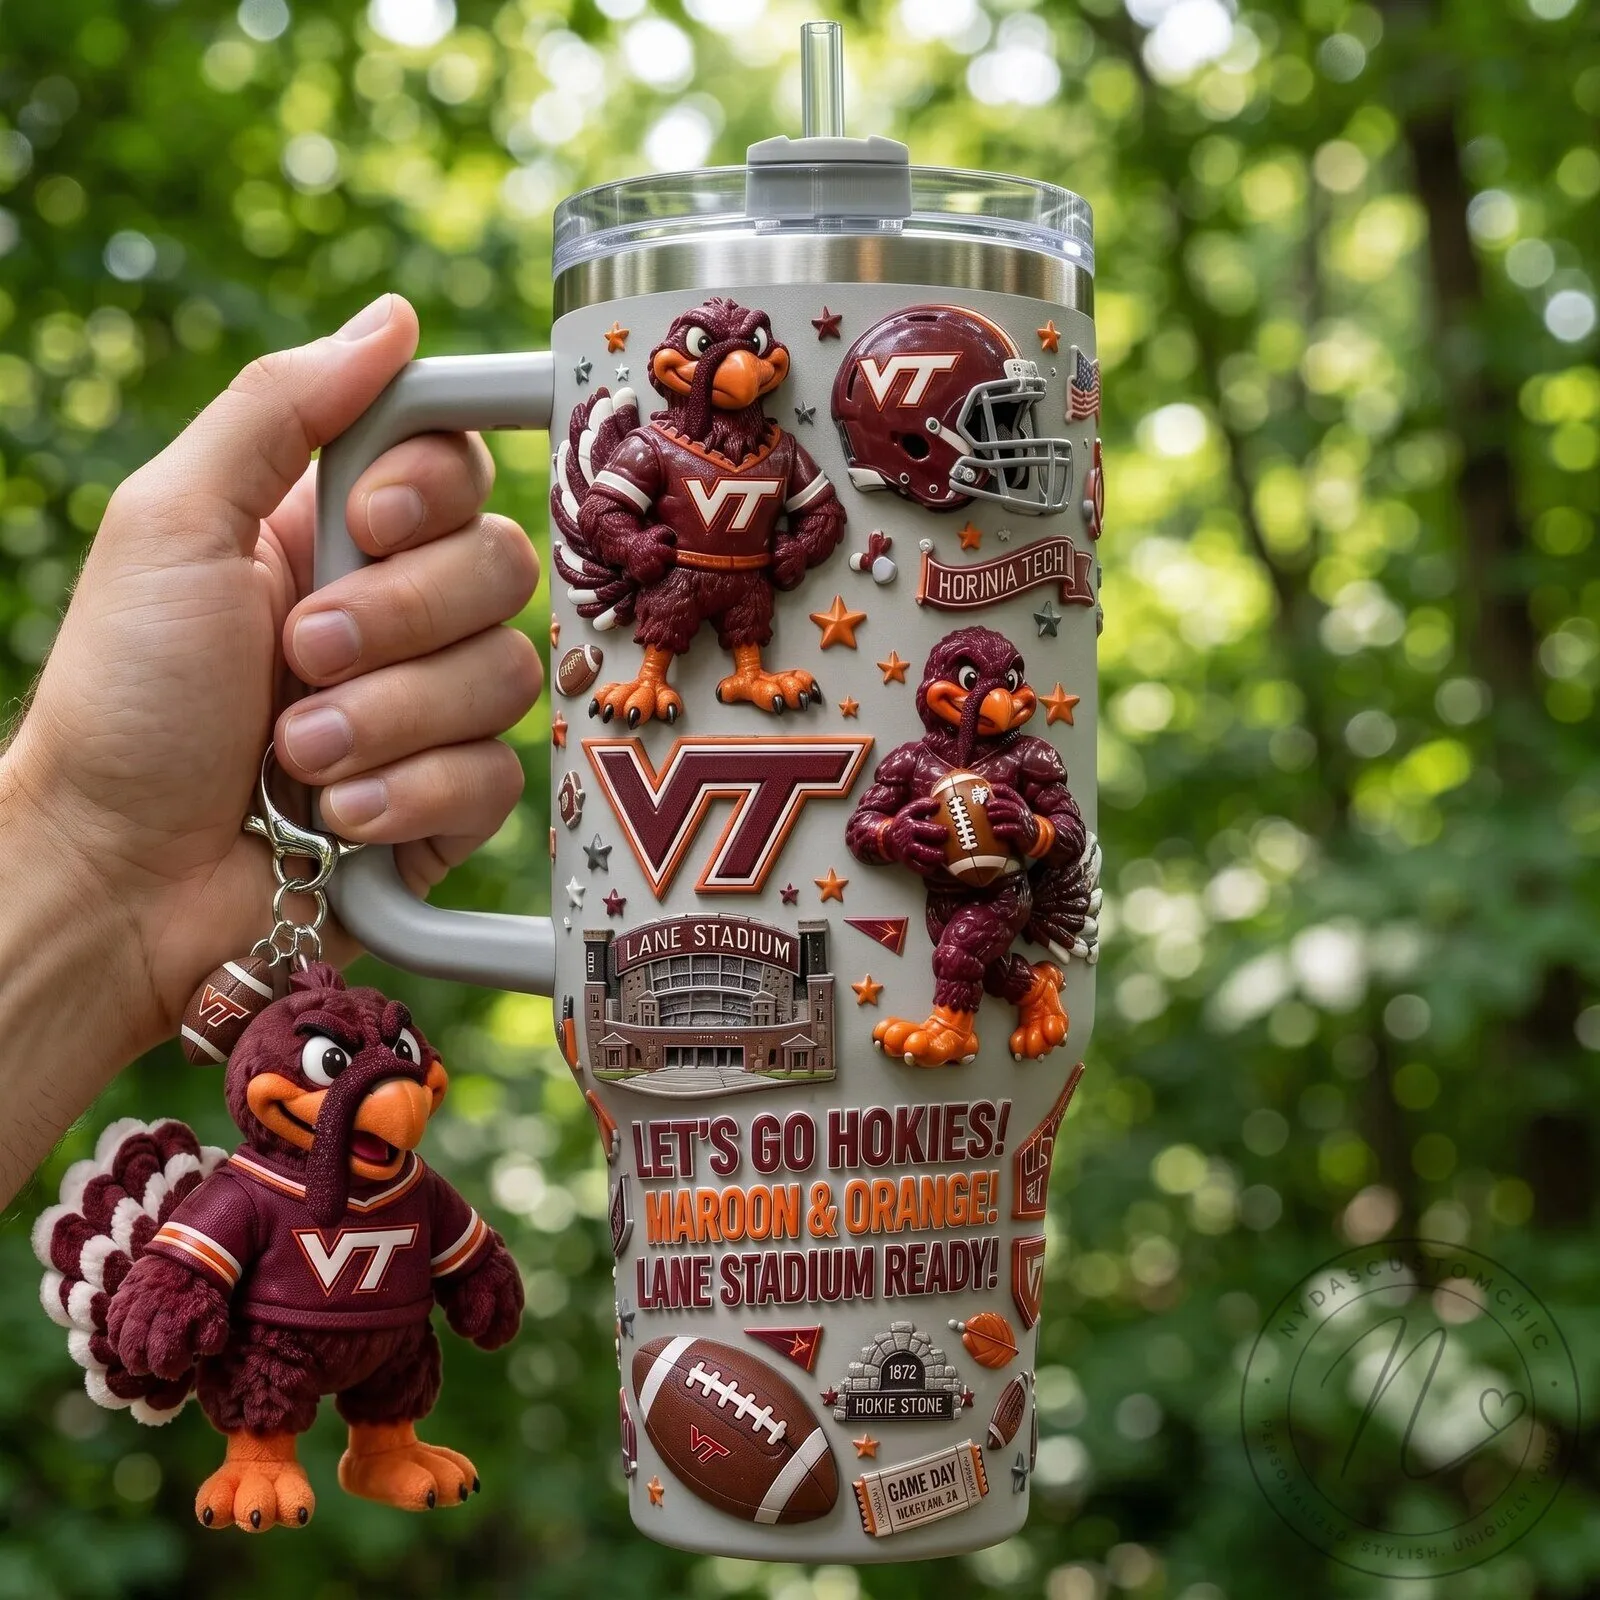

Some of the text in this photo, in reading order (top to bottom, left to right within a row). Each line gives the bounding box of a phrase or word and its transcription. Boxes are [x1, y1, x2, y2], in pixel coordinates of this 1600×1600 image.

[857, 351, 964, 412] VT
[681, 476, 787, 533] VT
[1022, 545, 1065, 588] TECH
[582, 736, 875, 900] VT
[626, 924, 790, 963] LANE STADIUM
[198, 984, 251, 1028] VT
[631, 1116, 740, 1179] LET'S
[750, 1111, 818, 1175] GO
[826, 1098, 1012, 1170] HOKIES!
[644, 1183, 802, 1246] MAROON
[807, 1180, 839, 1239] &
[844, 1170, 1000, 1236] ORANGE!
[292, 1223, 420, 1297] VT
[636, 1236, 999, 1310] LANE STADIUM READY!
[888, 1363, 918, 1381] 1872
[855, 1396, 943, 1415] HOKIE STONE
[689, 1423, 731, 1466] VT
[887, 1471, 929, 1503] GAME
[929, 1460, 957, 1490] DAY
